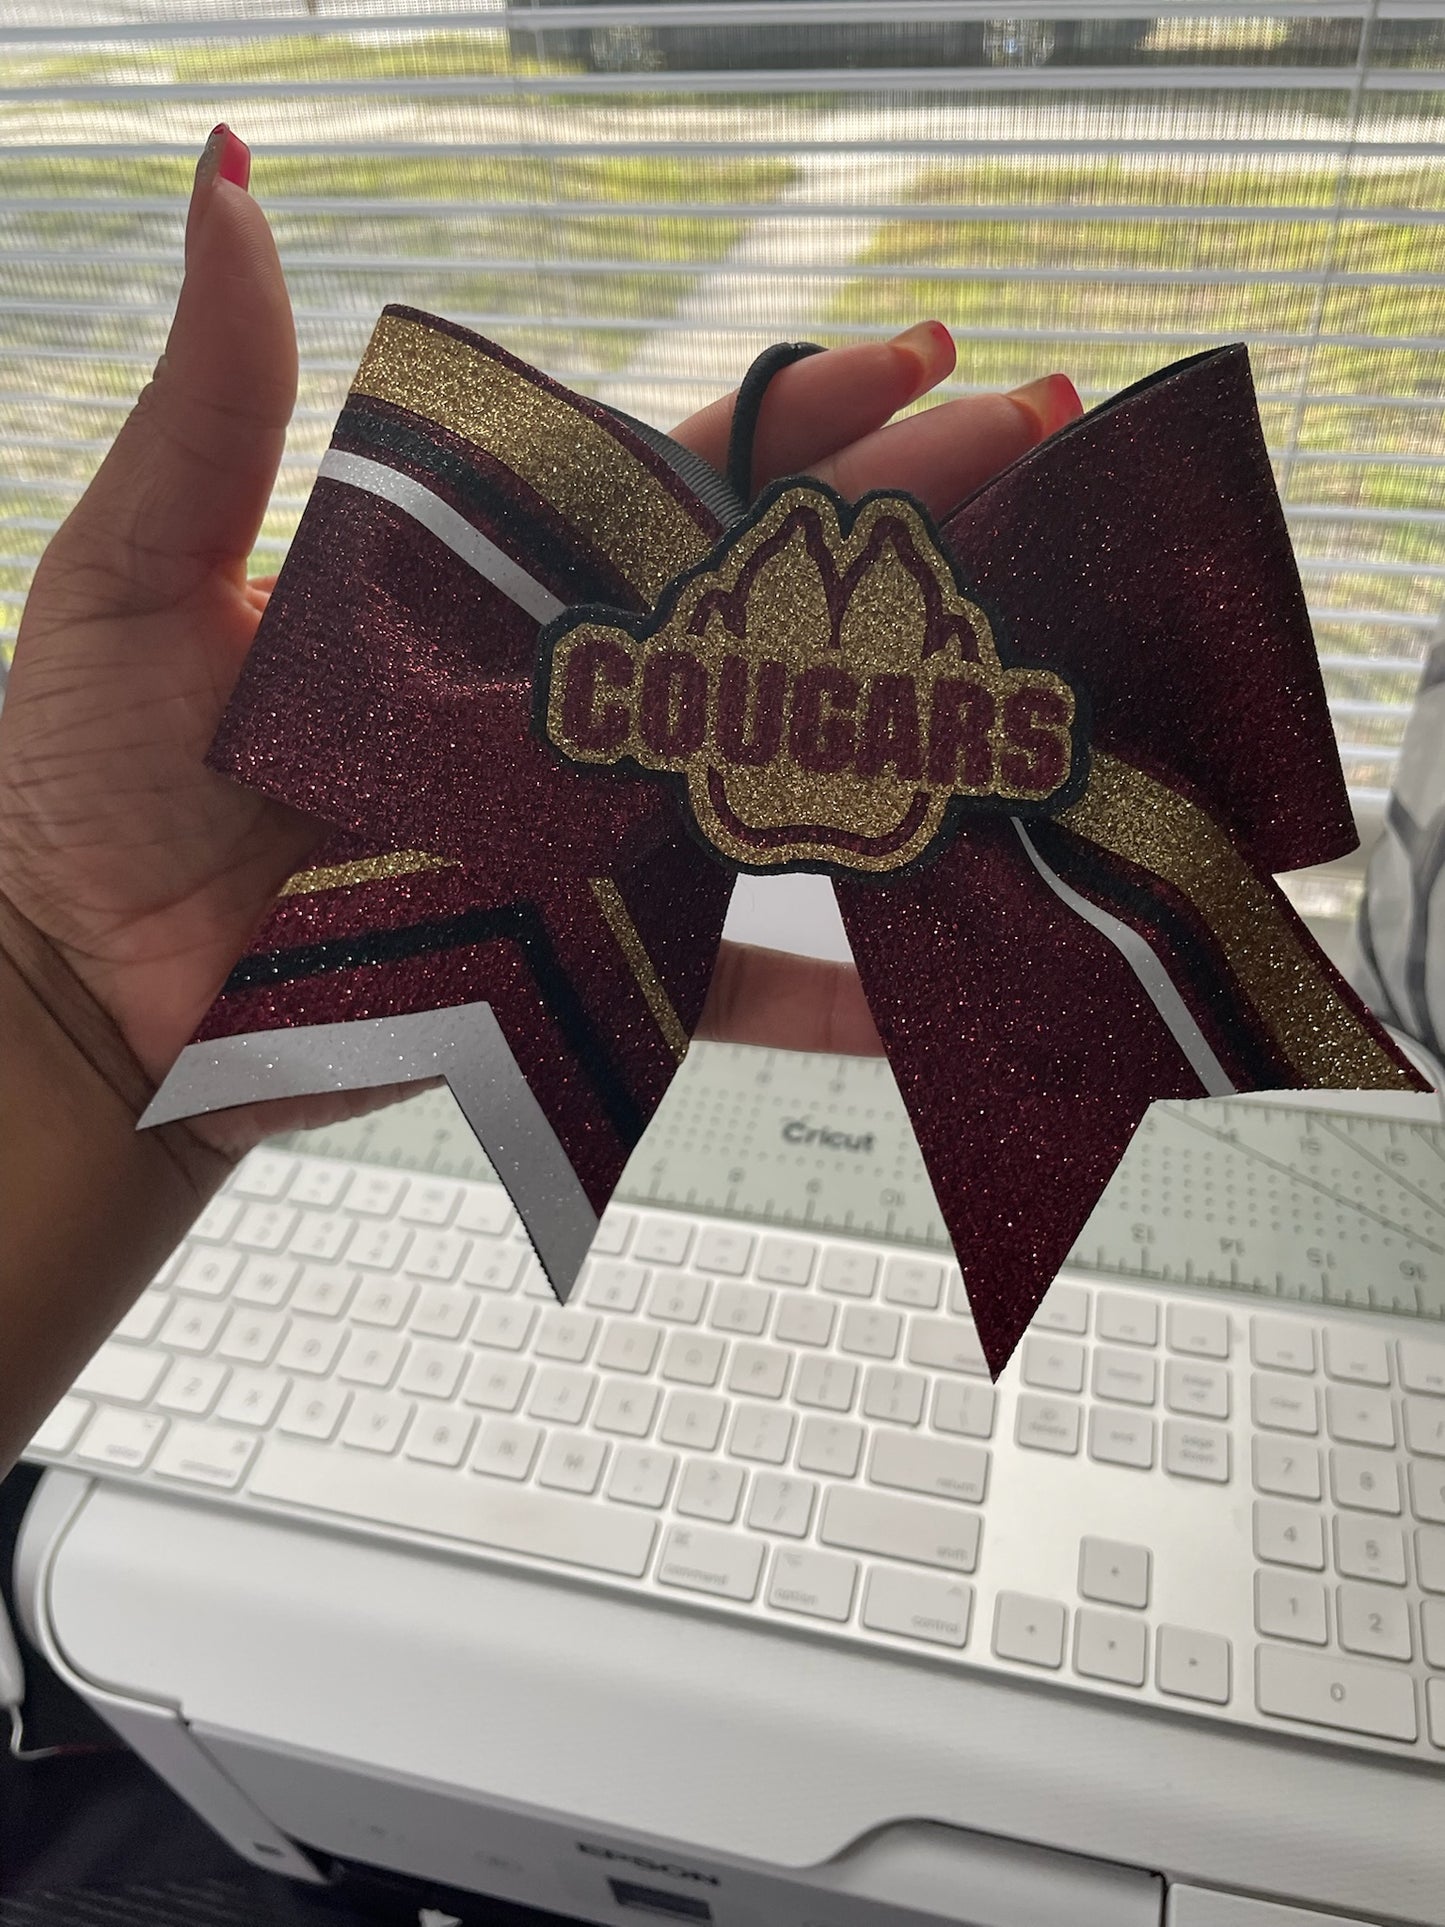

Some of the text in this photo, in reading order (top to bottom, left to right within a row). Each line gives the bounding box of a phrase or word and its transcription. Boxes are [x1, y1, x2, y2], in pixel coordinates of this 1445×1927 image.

[562, 639, 1069, 791] COUGARS
[781, 1119, 875, 1153] Cricut
[1283, 1526, 1297, 1543] 4
[1369, 1614, 1382, 1632] 2
[1330, 1683, 1346, 1702] 0
